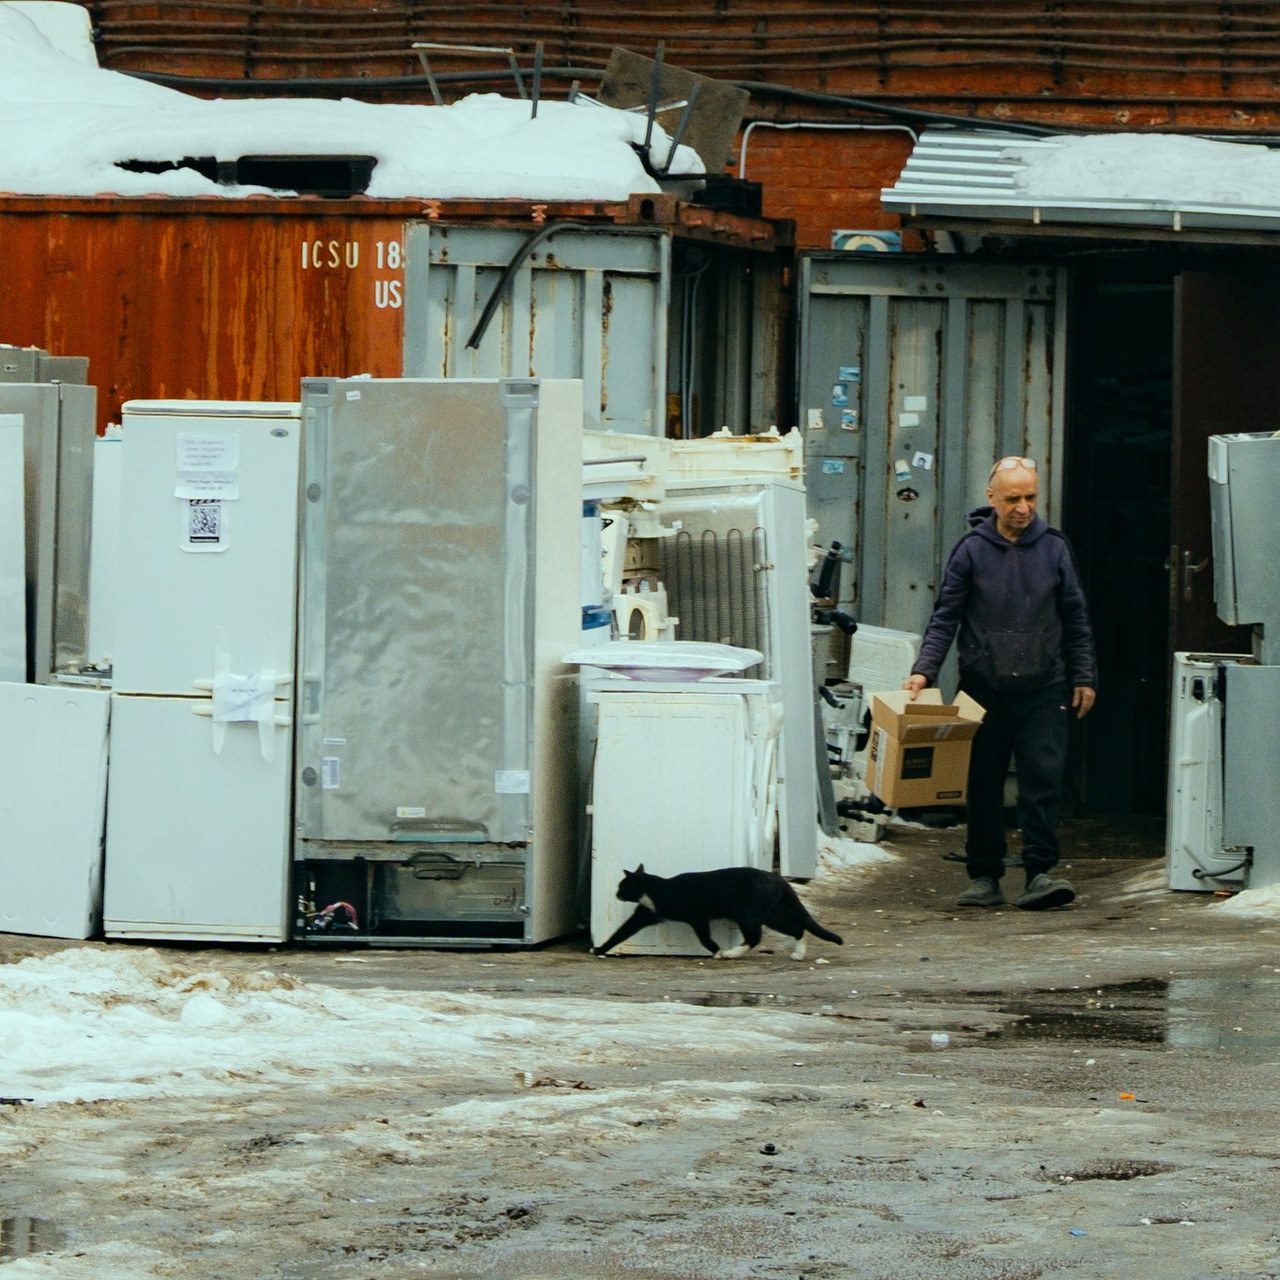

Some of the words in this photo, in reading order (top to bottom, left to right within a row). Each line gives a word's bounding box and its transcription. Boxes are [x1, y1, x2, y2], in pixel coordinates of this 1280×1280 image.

[302, 241, 359, 269] ICSU
[375, 241, 405, 269] 18
[375, 280, 402, 308] US
